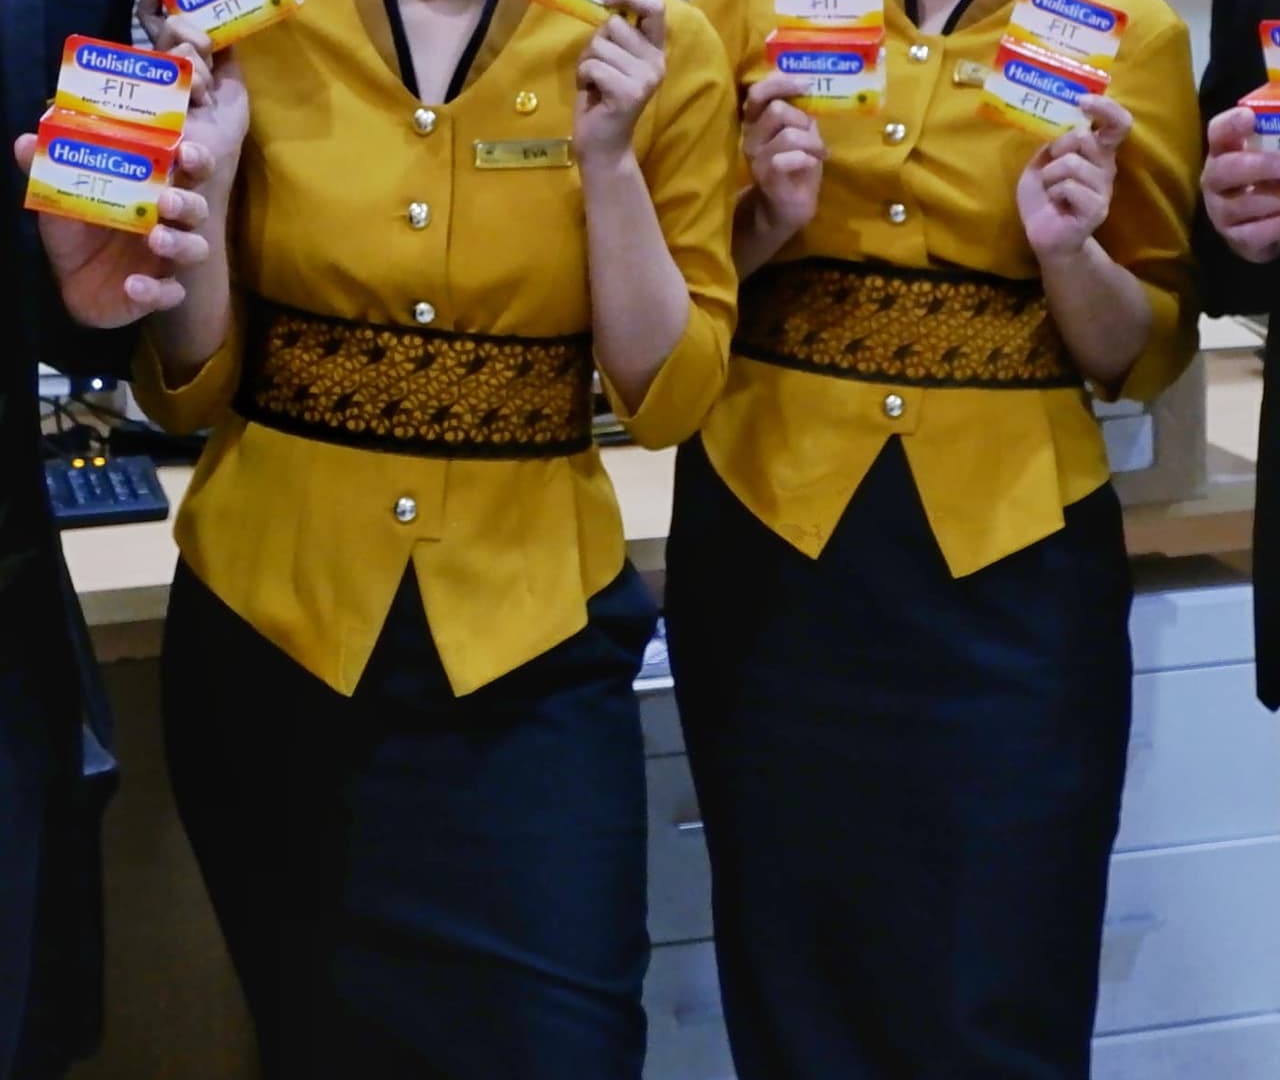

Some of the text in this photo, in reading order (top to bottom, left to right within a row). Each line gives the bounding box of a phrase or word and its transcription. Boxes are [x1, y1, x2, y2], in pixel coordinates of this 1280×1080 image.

[1048, 19, 1080, 40] FIT
[82, 50, 174, 82] HolistiCare
[781, 57, 860, 72] HolistiCare
[101, 78, 140, 100] FIT
[1022, 92, 1053, 114] FIT
[54, 143, 147, 179] HolistiCare
[72, 173, 113, 197] FIT
